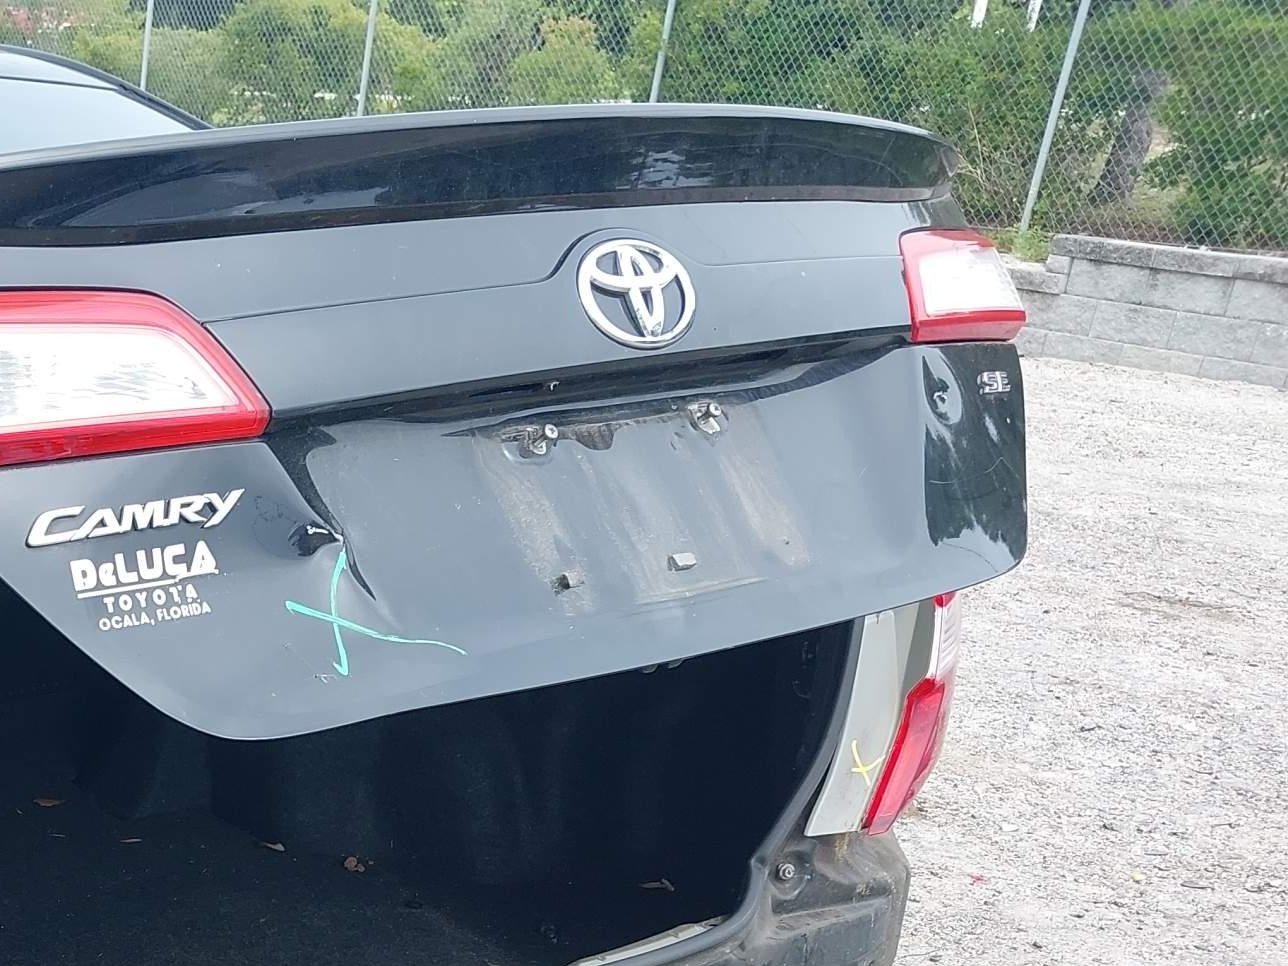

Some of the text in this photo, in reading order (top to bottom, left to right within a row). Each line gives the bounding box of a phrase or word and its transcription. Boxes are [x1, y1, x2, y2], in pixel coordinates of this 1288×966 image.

[981, 370, 1011, 394] SE
[25, 488, 245, 548] CAMRY
[70, 540, 219, 592] DeLUCA
[103, 583, 199, 613] TOYOTA
[98, 600, 212, 632] OCALA, FLORIDA
